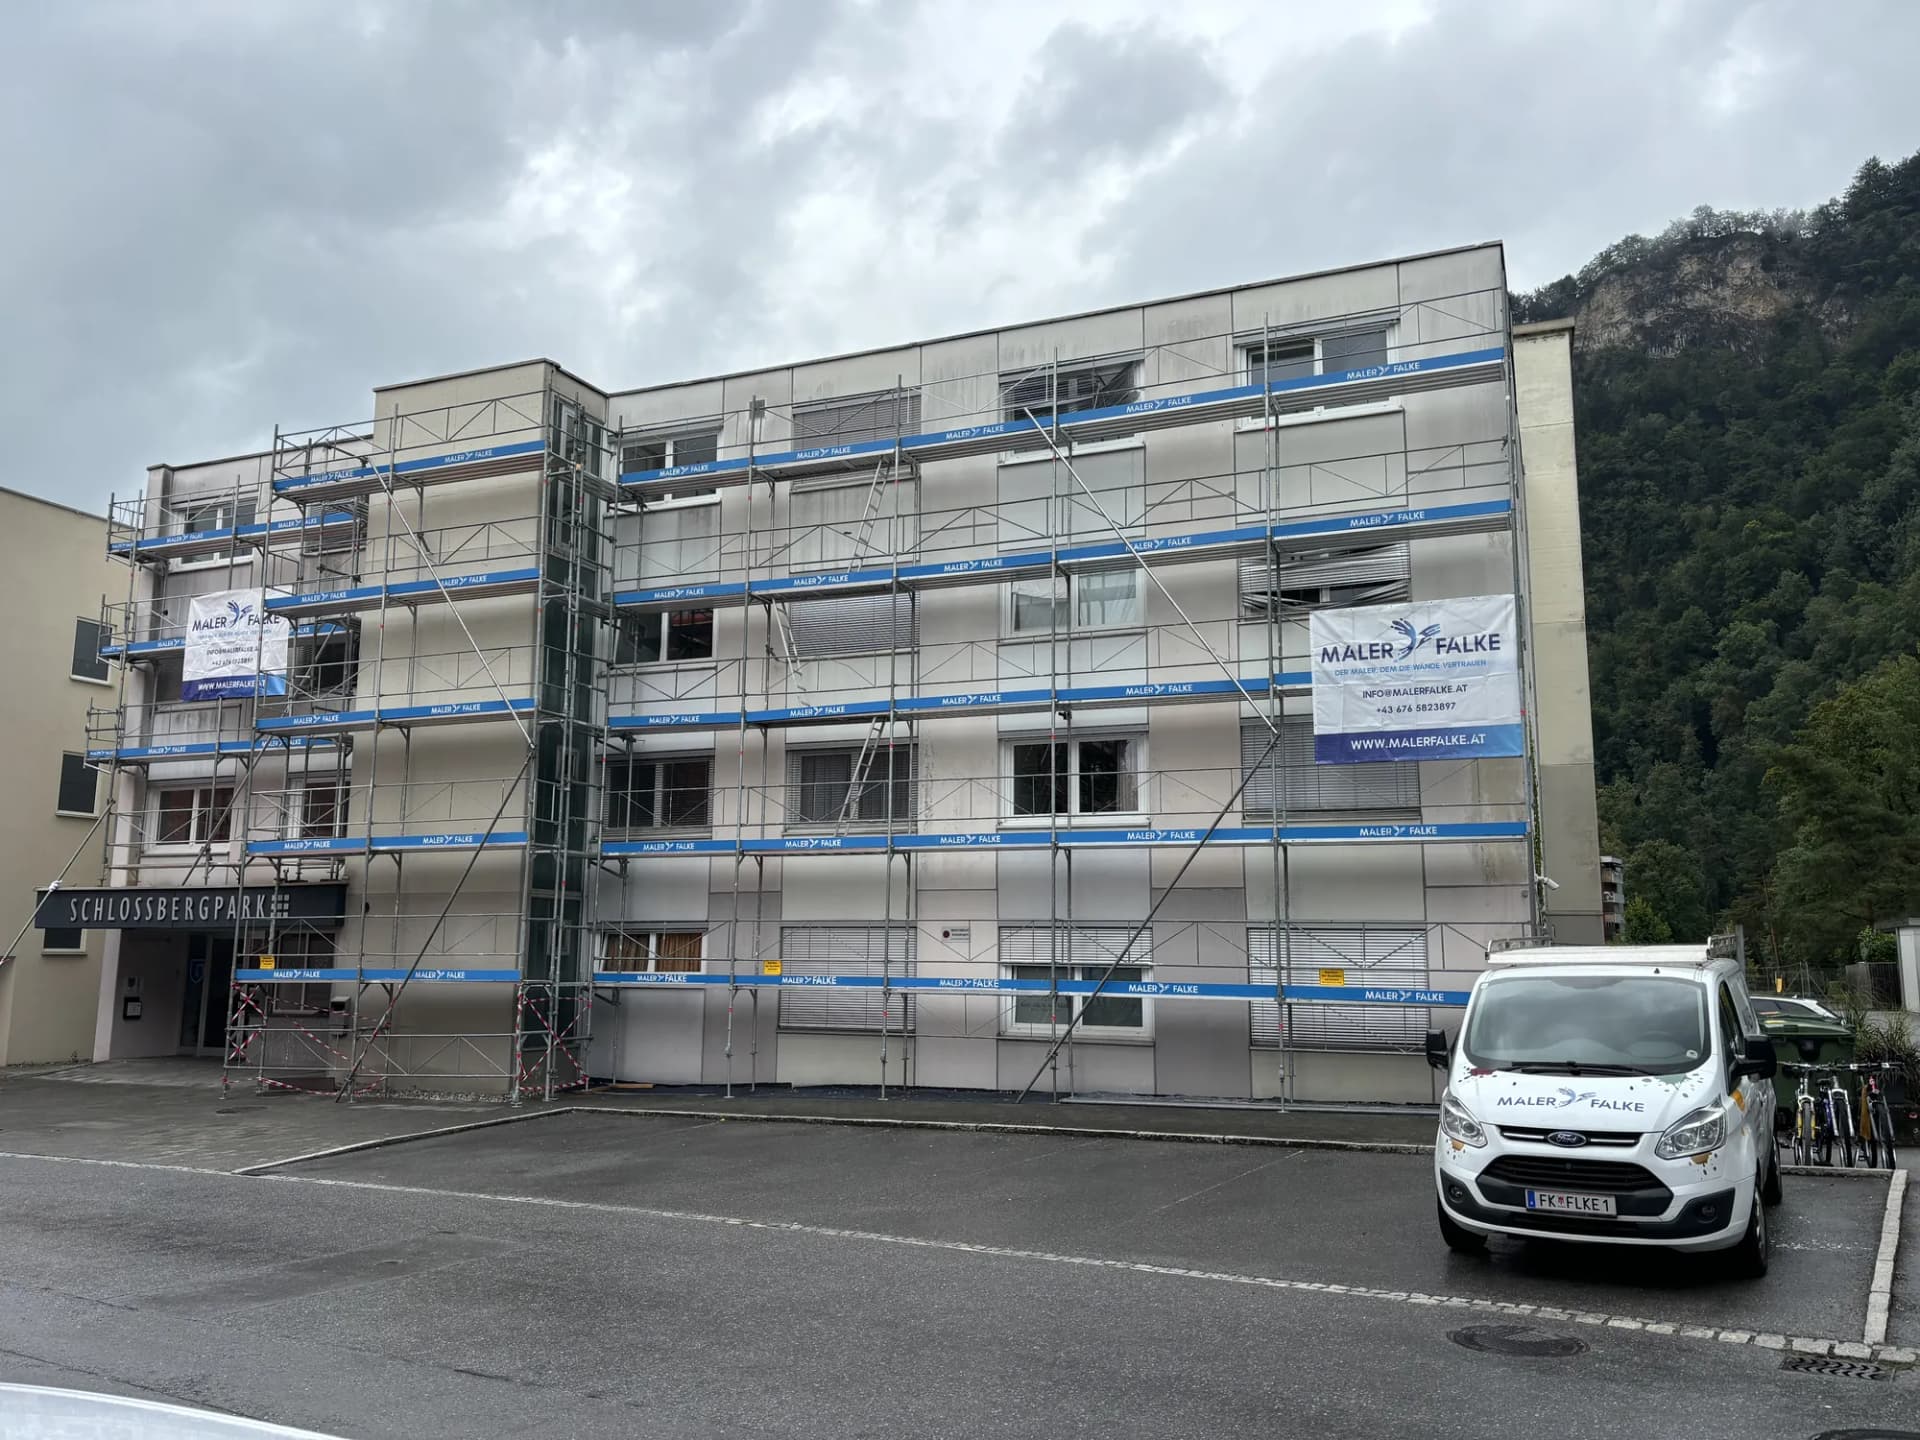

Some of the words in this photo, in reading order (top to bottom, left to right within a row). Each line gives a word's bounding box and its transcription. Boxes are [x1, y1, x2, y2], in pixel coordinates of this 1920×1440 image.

[1346, 367, 1377, 380] MALER
[1393, 361, 1421, 373] FALKE
[1126, 402, 1154, 413] MALER
[1167, 396, 1192, 407] FALKE
[945, 429, 971, 440] MALER
[982, 424, 1004, 435] FALKE
[444, 453, 465, 463] MALER
[474, 448, 492, 458] FALKE
[796, 448, 820, 459] MALER
[831, 446, 851, 456] FALKE
[659, 467, 681, 477] MALER
[690, 463, 709, 473] FALKE
[1350, 514, 1382, 527] MALER
[1398, 511, 1425, 522] FALKE
[1167, 536, 1192, 548] FALKE
[944, 561, 969, 573] MALER
[980, 558, 1003, 568] FALKE
[468, 574, 487, 584] FALKE
[793, 575, 817, 586] MALER
[828, 574, 849, 584] FALKE
[301, 592, 321, 601] MALER
[328, 591, 347, 600] FALKE
[654, 588, 677, 598] MALER
[685, 587, 705, 597] FALKE
[192, 616, 227, 632] MALER
[1320, 642, 1394, 664] MALER
[1435, 633, 1501, 656] FALKE
[1379, 665, 1398, 673] DEM
[1442, 659, 1487, 669] VERTRAUEN
[1125, 686, 1154, 696] MALER
[1168, 684, 1193, 694] FALKE
[1362, 684, 1468, 699] INFO@MALERFALKE.AT
[942, 695, 967, 705] MALER
[979, 693, 1002, 703] FALKE
[431, 704, 452, 713] MALER
[462, 703, 481, 712] FALKE
[789, 707, 814, 717] MALER
[825, 704, 846, 714] FALKE
[1376, 706, 1394, 715] +43
[1396, 704, 1413, 713] 676
[1415, 702, 1457, 712] 5823897
[293, 715, 313, 725] MALER
[321, 714, 339, 723] FALKE
[648, 715, 671, 724] MALER
[680, 714, 700, 723] FALKE
[1350, 733, 1486, 751] WWW.MALERFALKE.AT
[1127, 831, 1156, 841] MALER
[1170, 830, 1196, 840] FALKE
[1359, 827, 1392, 837] MALER
[1409, 826, 1438, 836] FALKE
[284, 840, 304, 849] MALER
[313, 840, 331, 849] FALKE
[422, 835, 444, 844] MALER
[454, 834, 473, 843] FALKE
[785, 838, 810, 848] MALER
[820, 838, 842, 847] FALKE
[940, 835, 966, 844] MALER
[978, 835, 1002, 844] FALKE
[643, 843, 665, 851] MALER
[675, 842, 695, 851] FALKE
[69, 894, 265, 922] SCHLOSSBERGPARK
[273, 969, 294, 978] MALER
[302, 969, 321, 978] FALKE
[415, 971, 436, 979] MALER
[446, 970, 465, 979] FALKE
[637, 974, 660, 982] MALER
[664, 973, 687, 983] FALKE
[781, 976, 806, 985] MALER
[812, 974, 837, 985] FALKE
[939, 978, 964, 988] MALER
[972, 977, 999, 988] FALKE
[1128, 983, 1158, 994] MALER
[1173, 984, 1199, 994] FALKE
[1365, 990, 1398, 1001] MALER
[1415, 991, 1444, 1002] FALKE
[1497, 1096, 1557, 1107] MALER
[1590, 1098, 1645, 1113] FALKE
[1539, 1193, 1556, 1208] FK
[1566, 1196, 1601, 1212] FLKE
[1602, 1199, 1609, 1213] 1
